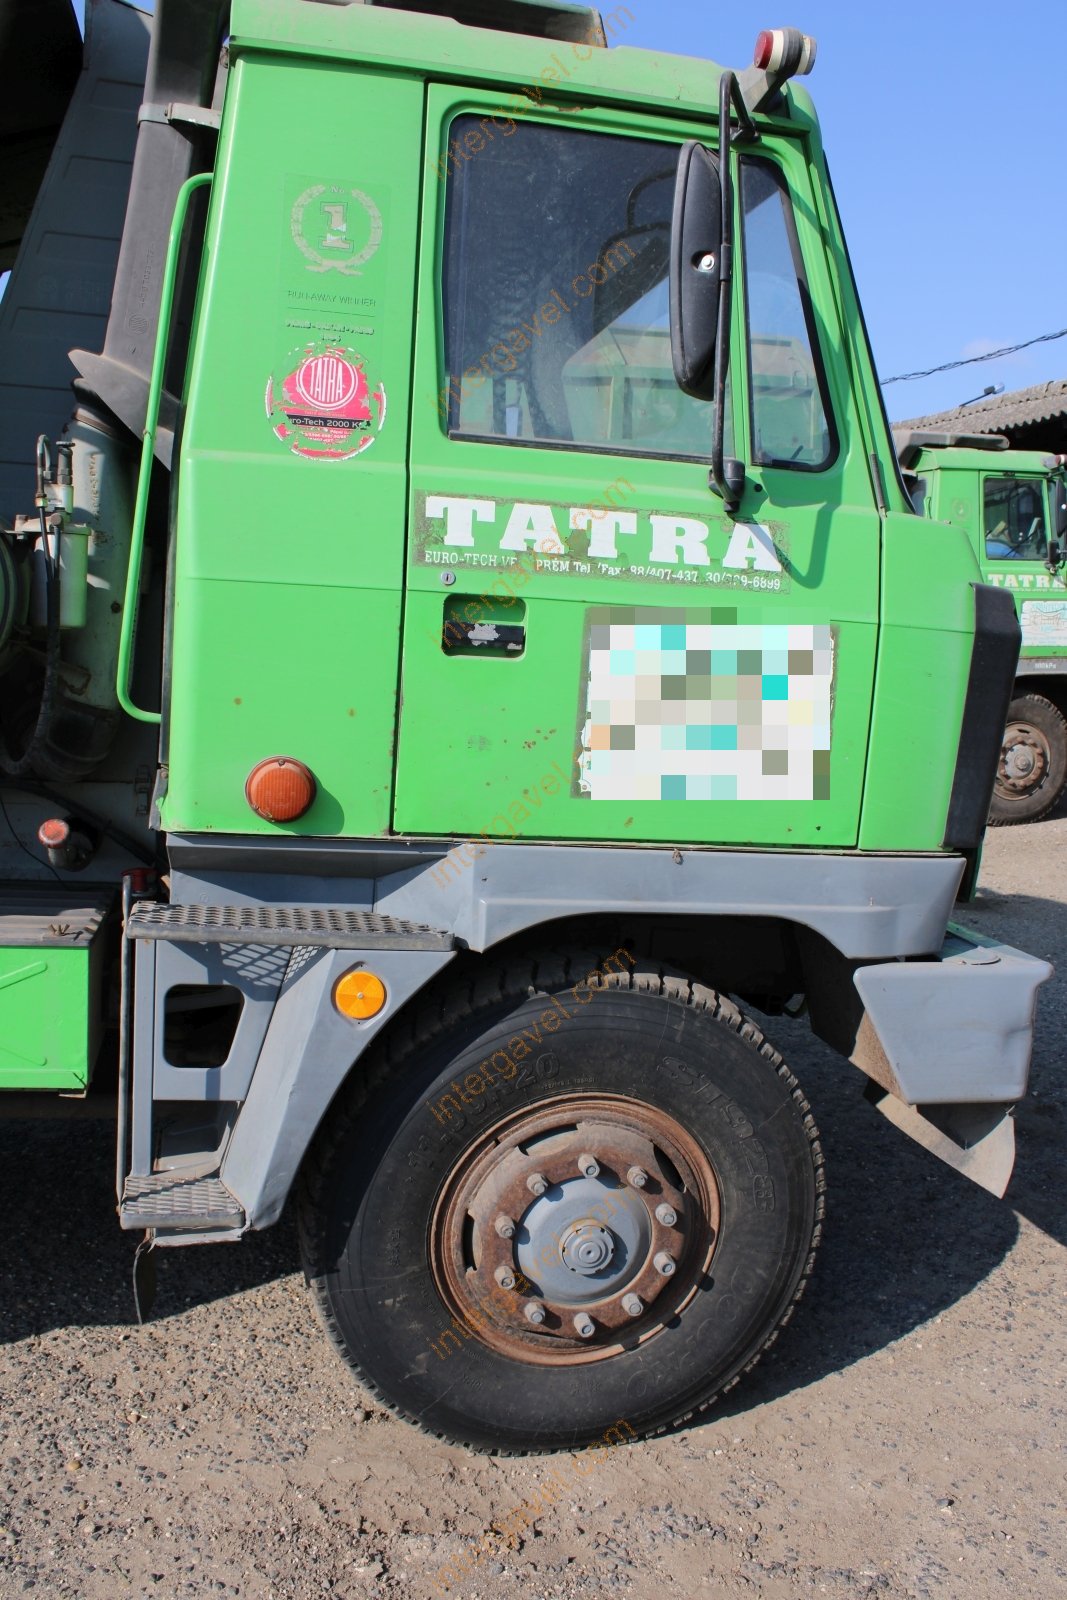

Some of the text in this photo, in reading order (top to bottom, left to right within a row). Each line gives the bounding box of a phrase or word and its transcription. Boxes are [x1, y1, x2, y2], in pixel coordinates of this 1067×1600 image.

[319, 202, 354, 252] 1
[310, 356, 344, 403] TATRA
[289, 417, 325, 426] ro-Tech
[326, 419, 350, 428] 2000
[425, 495, 783, 571] TATRA
[424, 549, 497, 567] EURO-TECH
[987, 573, 1067, 588] TATRA
